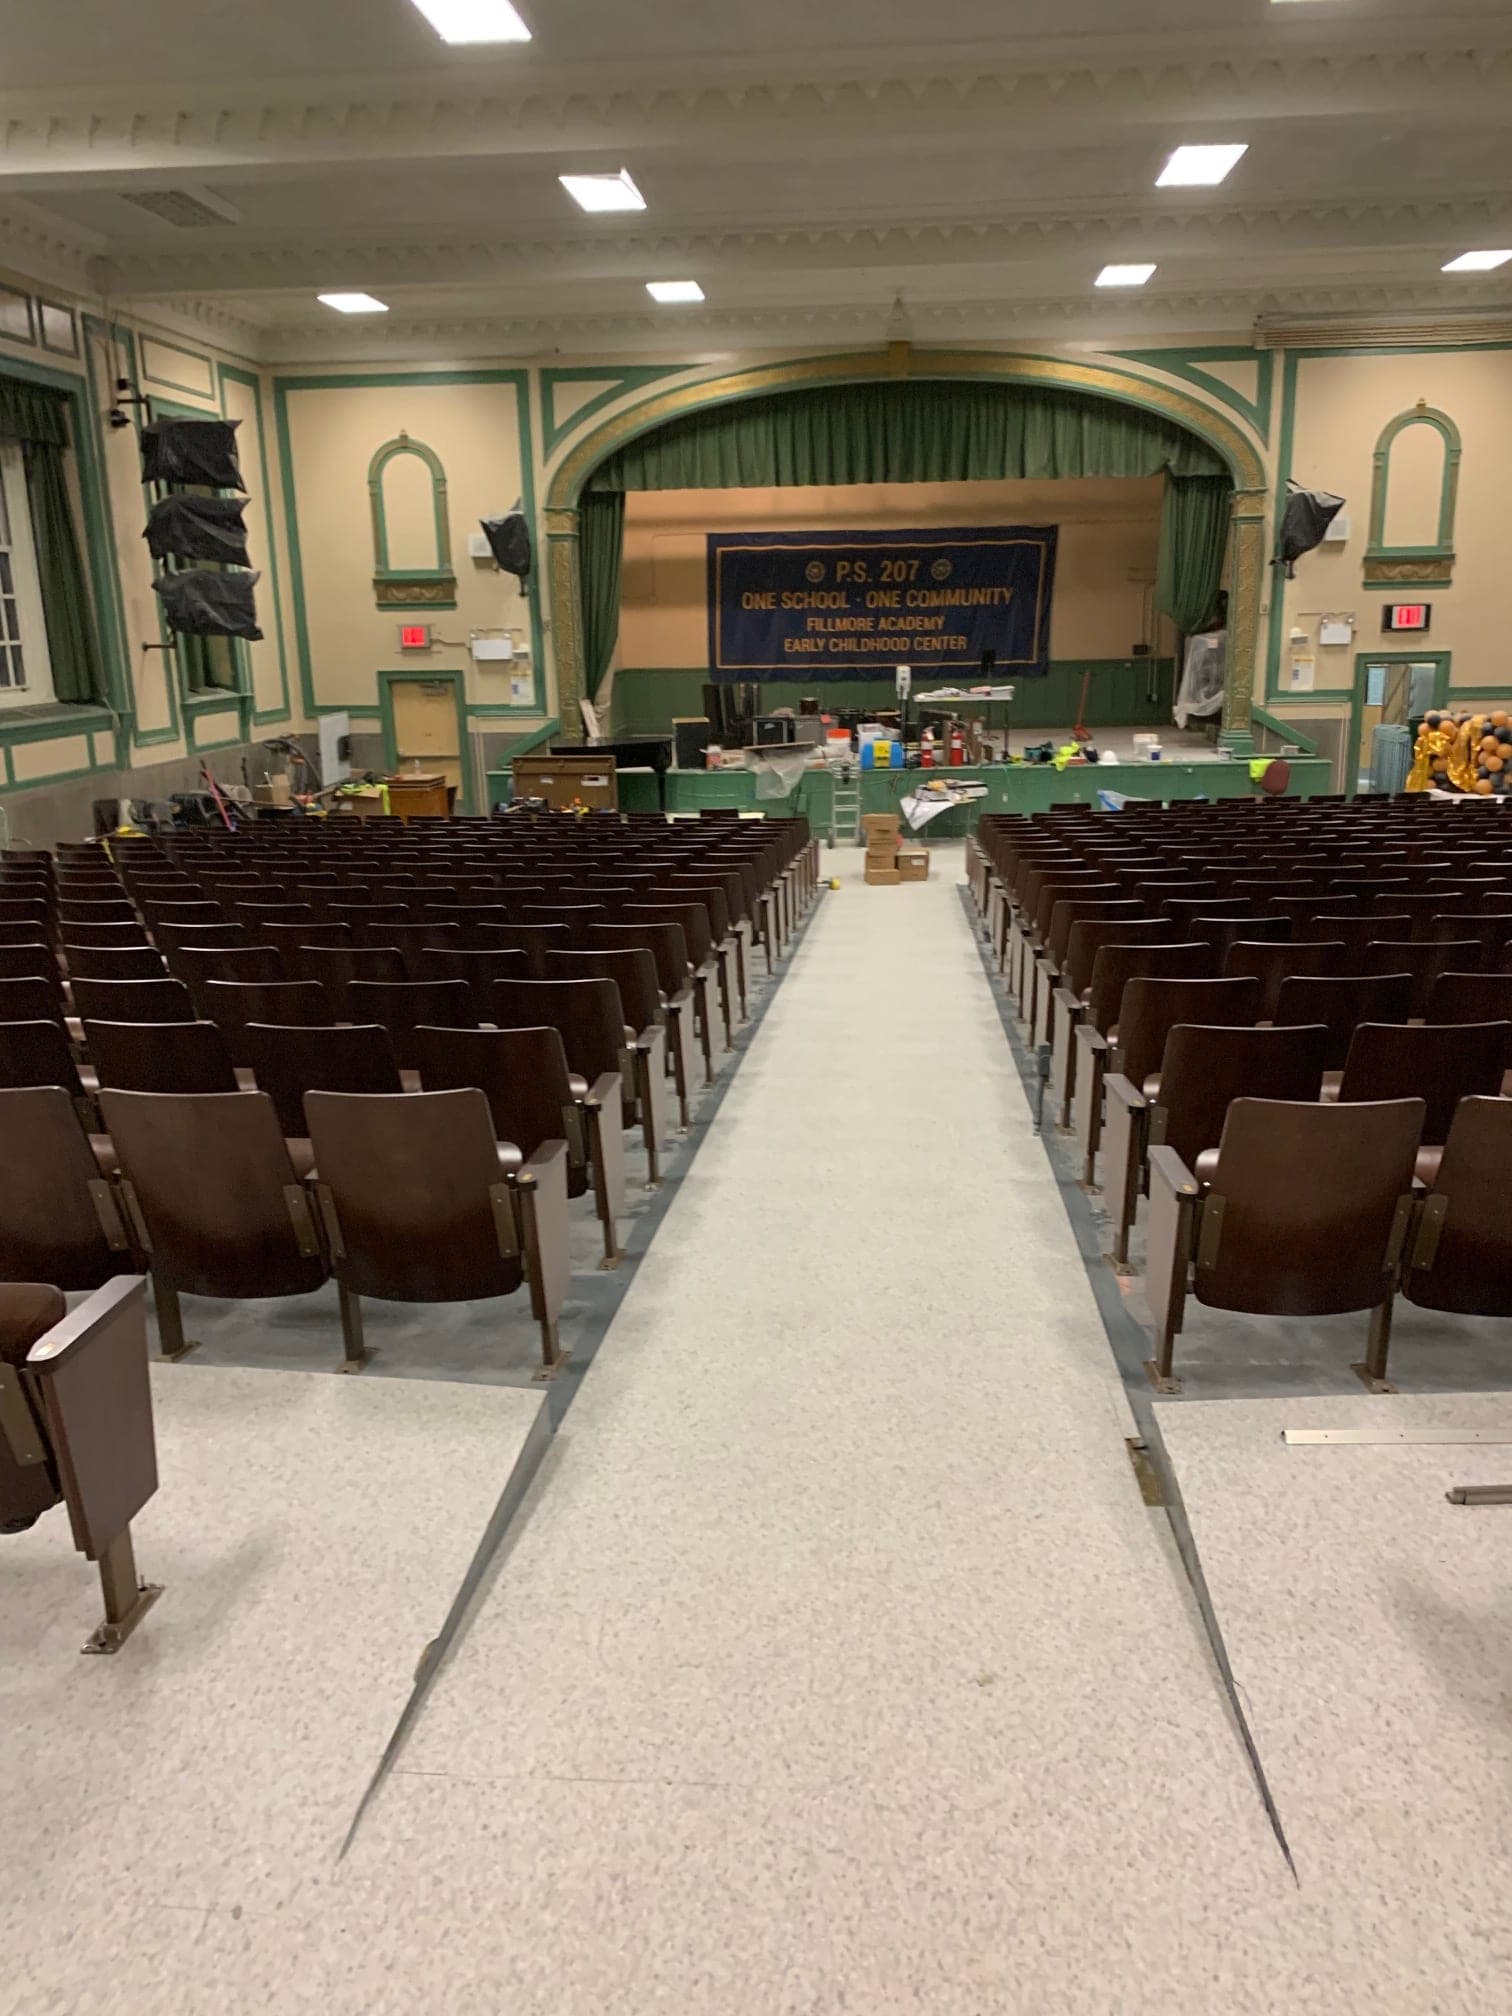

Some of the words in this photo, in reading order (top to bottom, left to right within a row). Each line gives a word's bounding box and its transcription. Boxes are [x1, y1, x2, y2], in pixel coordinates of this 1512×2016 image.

[836, 561, 872, 583] P.S.
[880, 560, 920, 582] 207
[742, 592, 777, 610] ONE
[781, 591, 851, 609] SCHOOL
[865, 590, 901, 608] ONE
[906, 587, 1013, 607] COMMUNITY
[806, 617, 875, 632] FILLMORE
[878, 616, 945, 631] ACADEMY
[784, 638, 825, 652] EARLY
[828, 637, 910, 652] CHILDHOOD
[913, 635, 968, 651] CENTER
